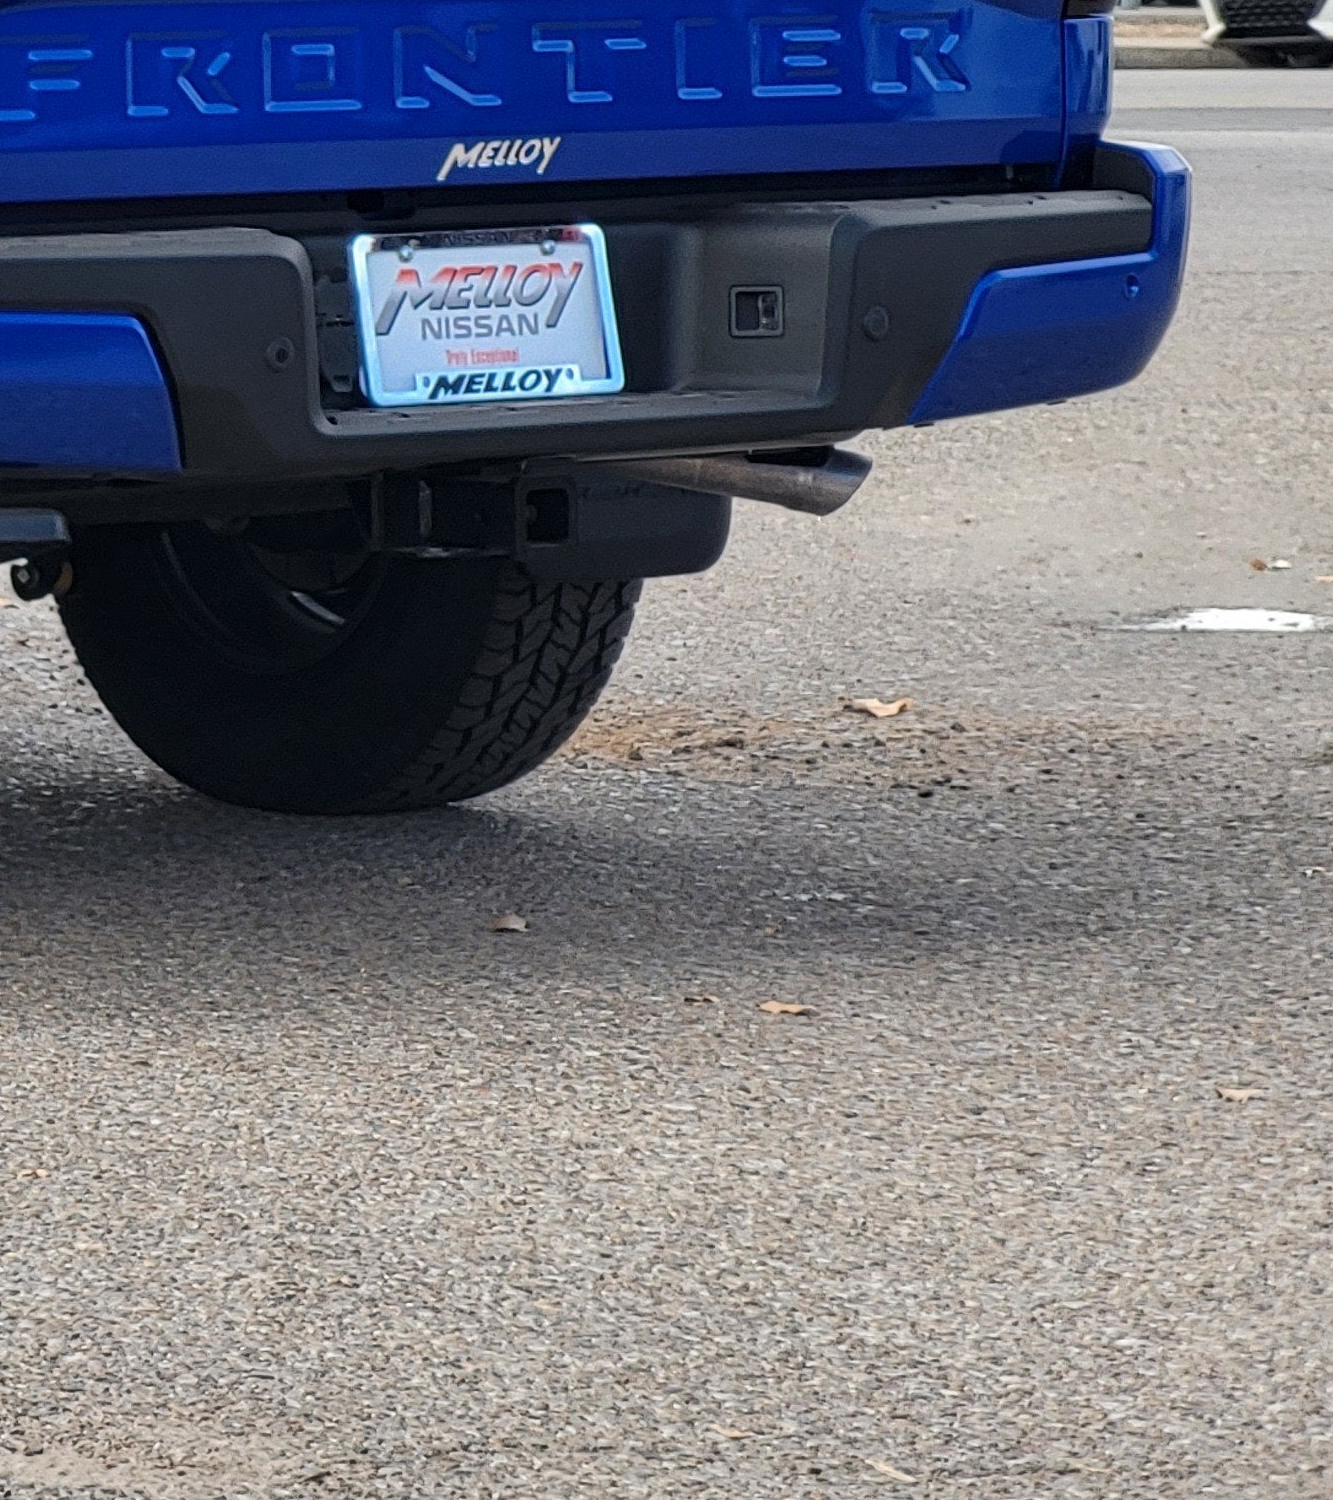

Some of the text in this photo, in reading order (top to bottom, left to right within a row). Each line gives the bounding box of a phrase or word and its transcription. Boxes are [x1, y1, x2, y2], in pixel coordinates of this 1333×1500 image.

[436, 136, 561, 181] MELLOY
[375, 262, 583, 336] MELLOY
[421, 312, 540, 341] NISSAN
[428, 367, 563, 400] MELLOY
